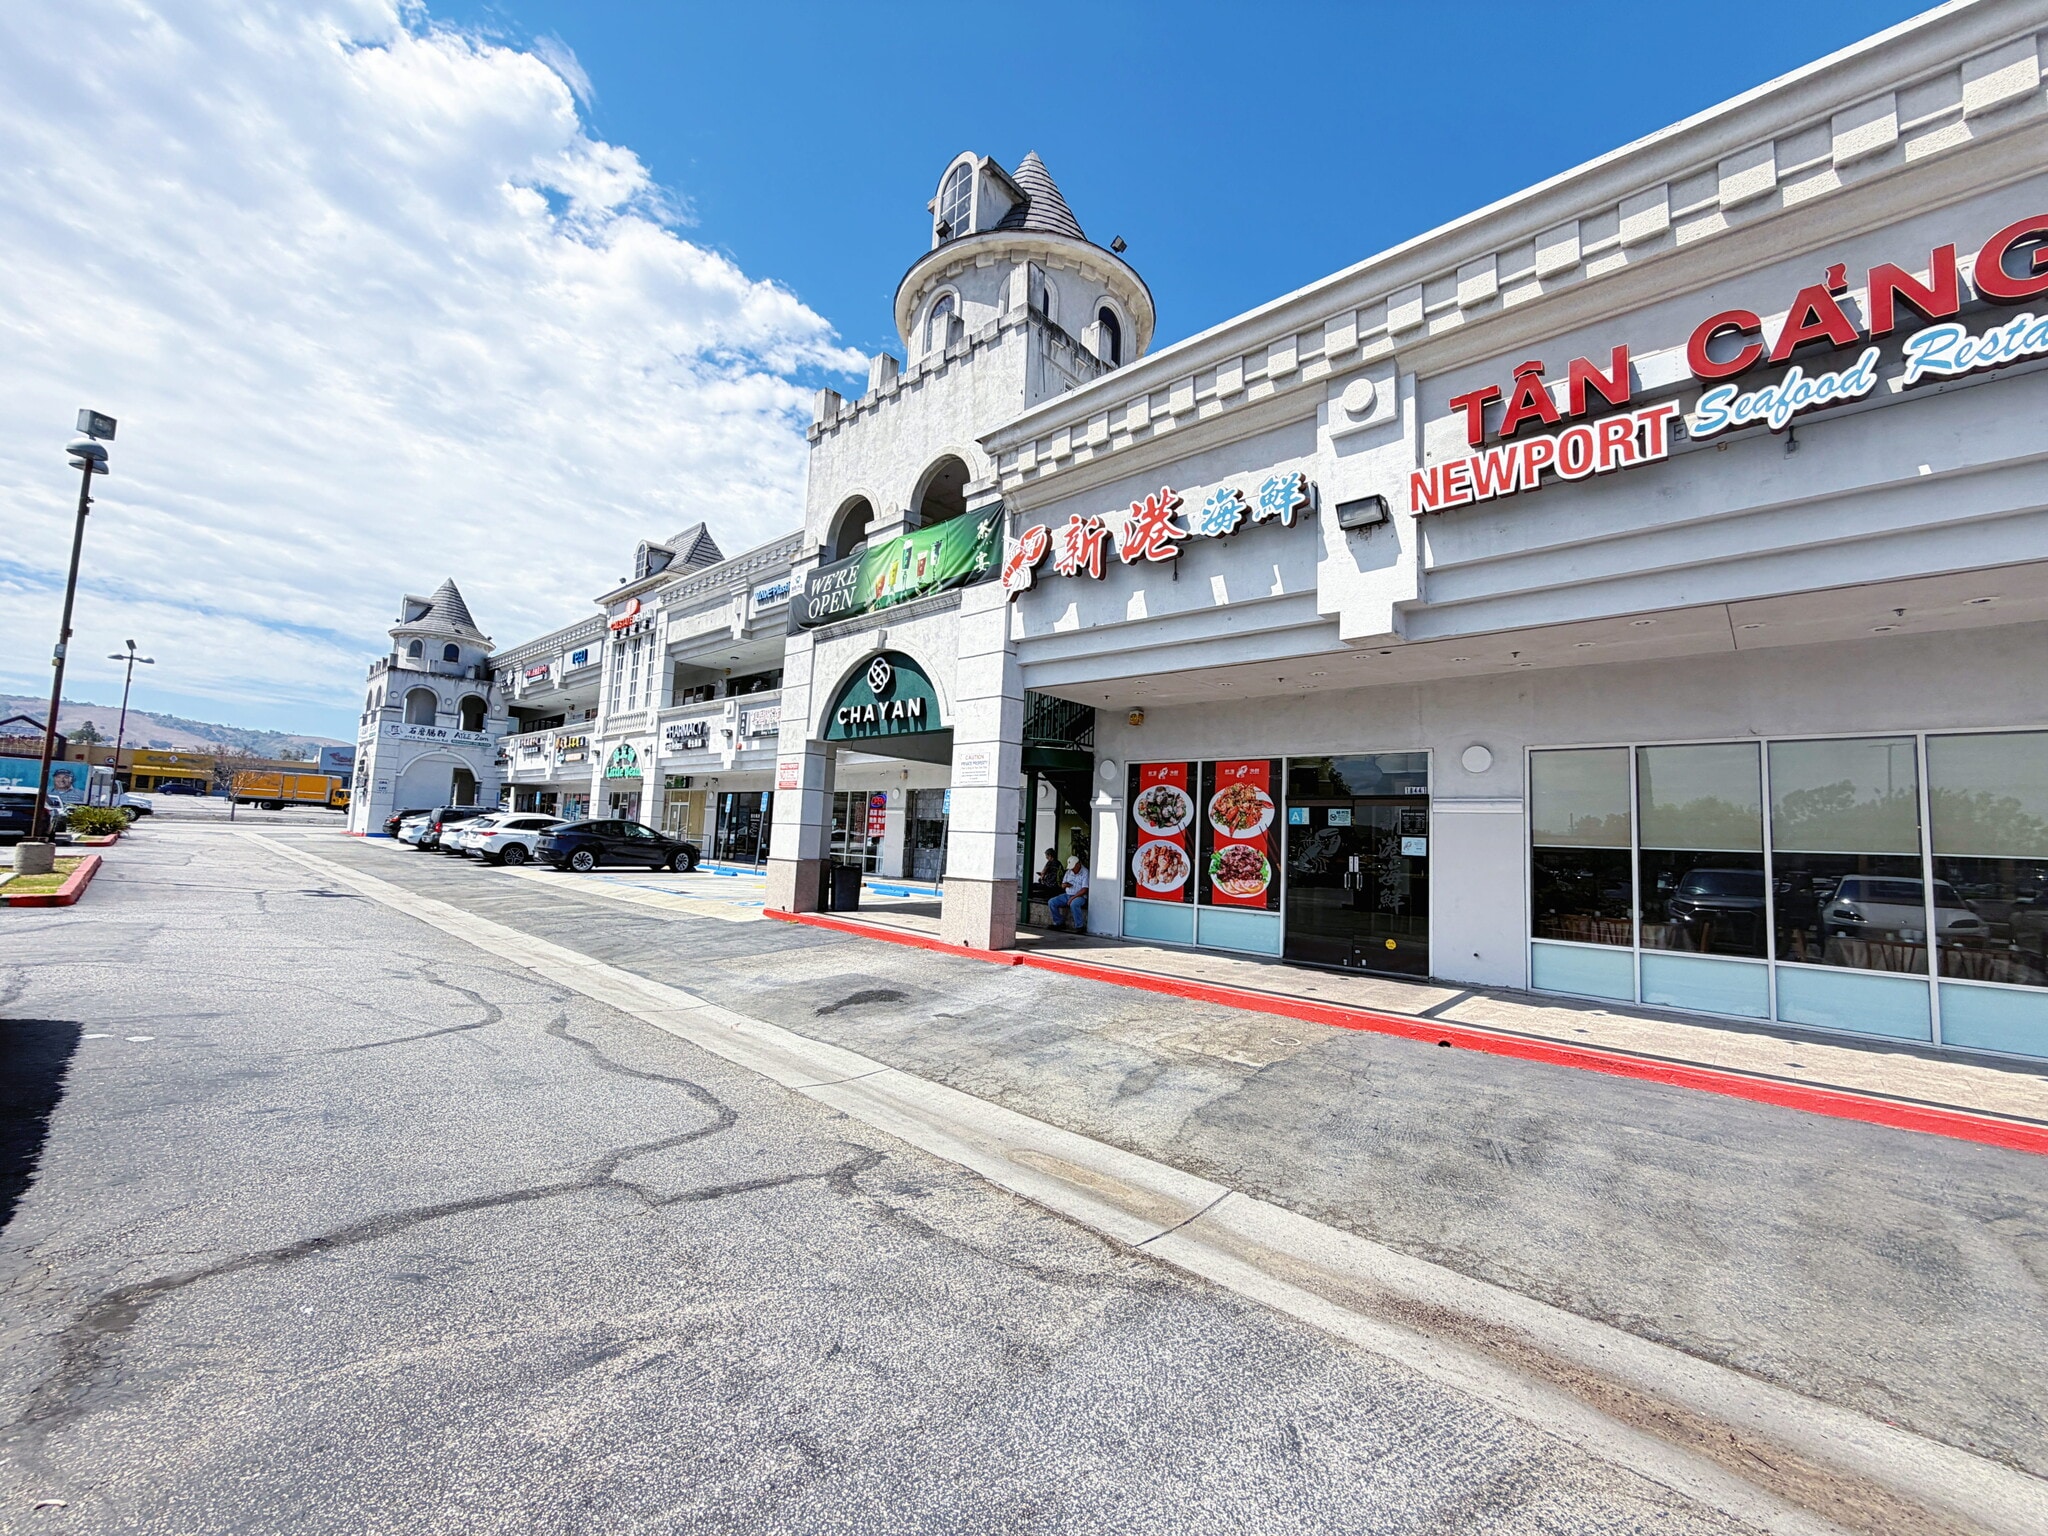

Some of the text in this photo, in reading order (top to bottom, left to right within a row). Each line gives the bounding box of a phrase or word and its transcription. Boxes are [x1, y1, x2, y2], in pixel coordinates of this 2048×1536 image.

[1449, 213, 2048, 446] TÂN CẢNG
[1408, 401, 1679, 515] NEWPORT
[1690, 347, 1879, 435] Seafood
[1054, 472, 1304, 579] 新港海鮮
[810, 565, 860, 597] WE'RE
[808, 586, 857, 619] OPEN
[837, 697, 921, 725] CHAYAN
[666, 722, 704, 738] PHARMACY
[1291, 811, 1300, 821] A
